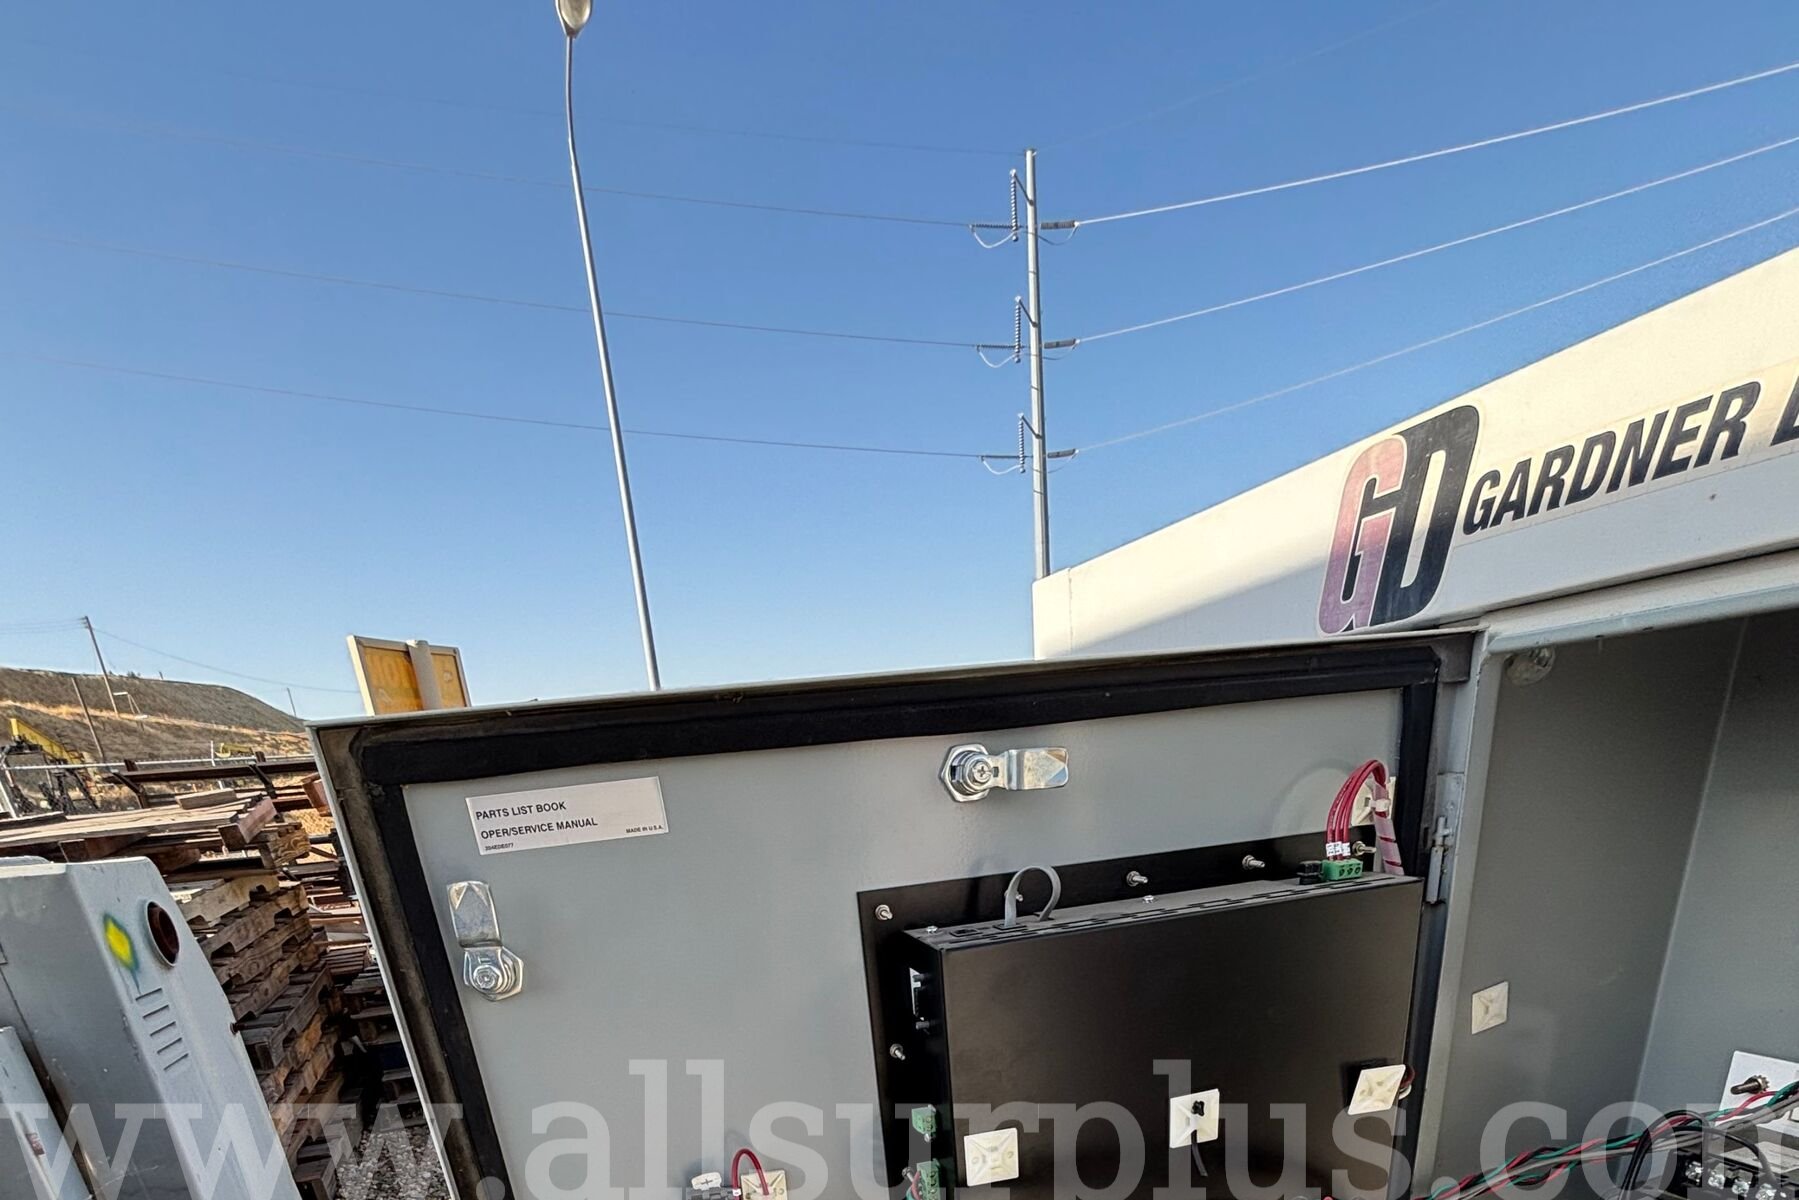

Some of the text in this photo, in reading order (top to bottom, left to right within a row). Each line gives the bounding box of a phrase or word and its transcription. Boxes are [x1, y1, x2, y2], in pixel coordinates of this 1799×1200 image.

[1463, 380, 1761, 536] GARDNER
[475, 801, 567, 820] PARTS LIST BOOK
[481, 817, 598, 839] OPER/SERVICE MANUAL
